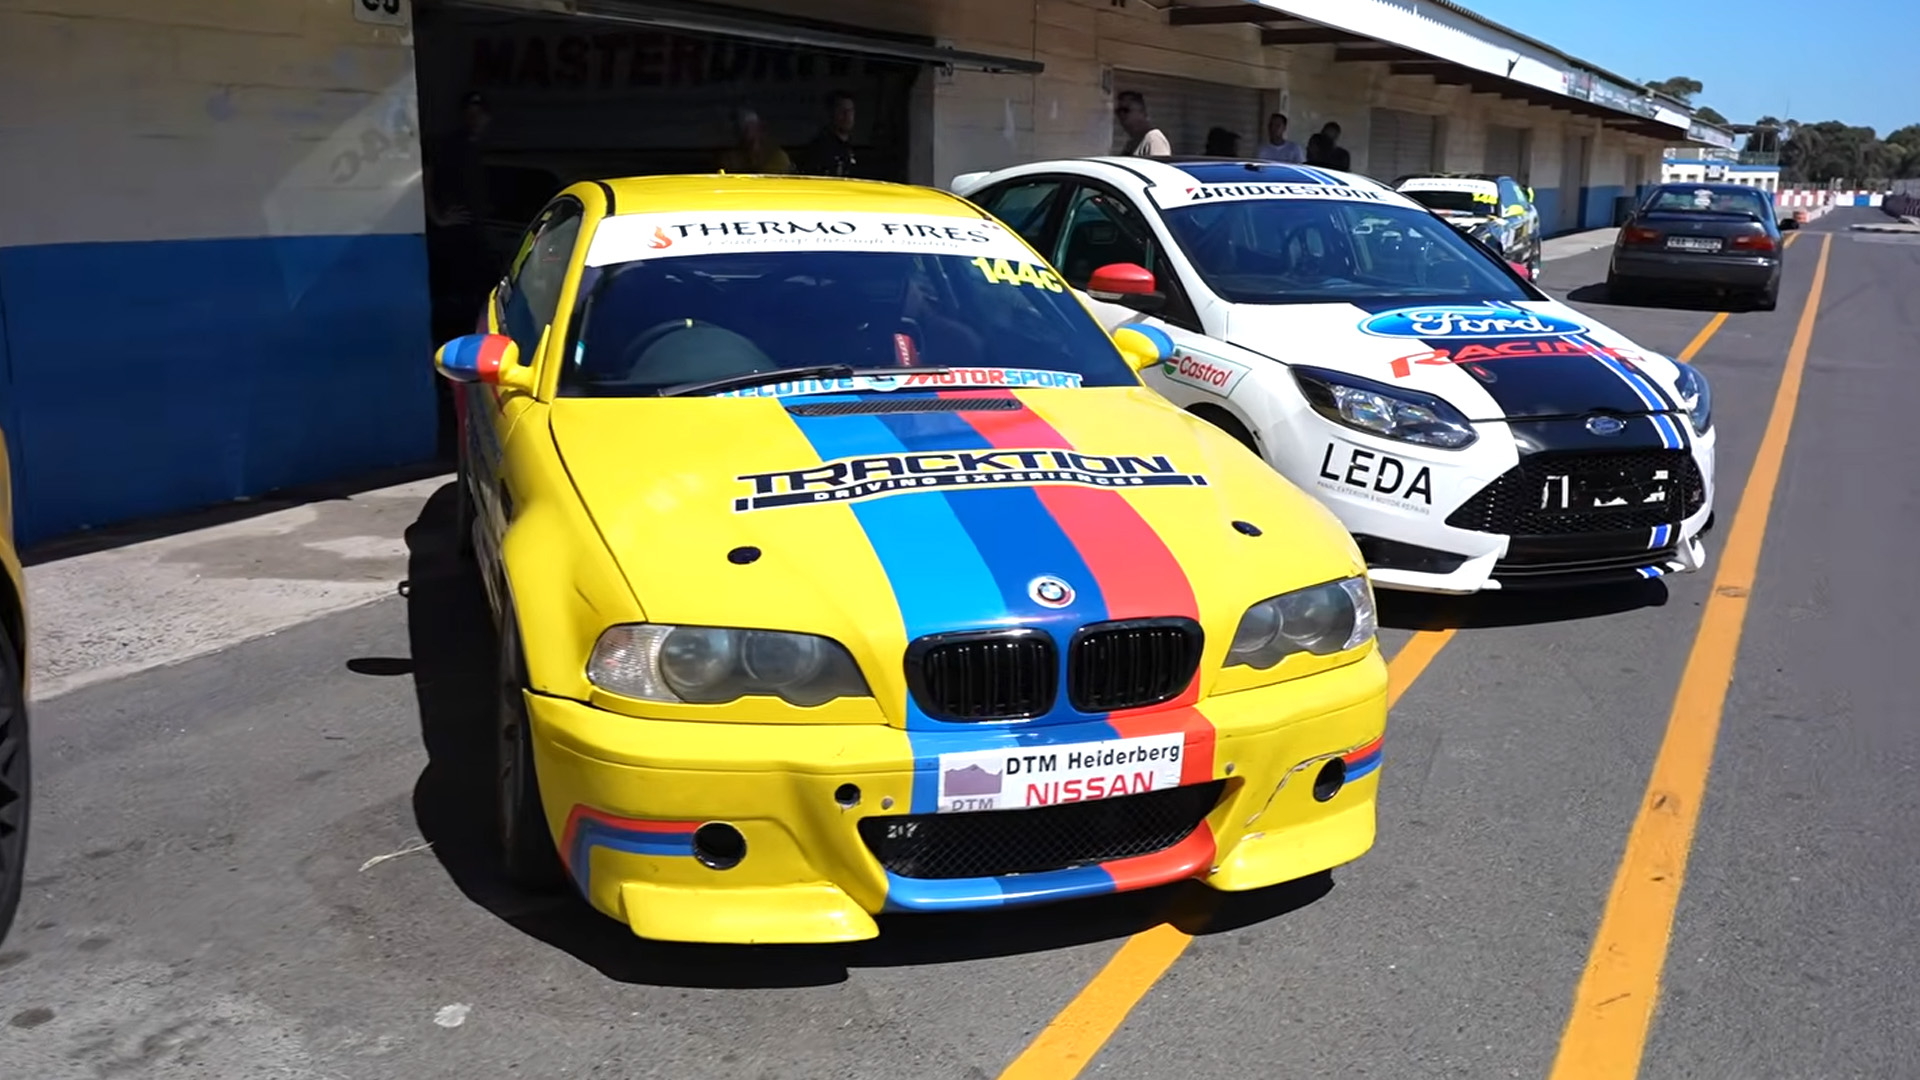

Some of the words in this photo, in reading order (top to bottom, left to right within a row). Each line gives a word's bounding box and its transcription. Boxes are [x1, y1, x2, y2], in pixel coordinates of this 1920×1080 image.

[1191, 184, 1388, 202] BRIDGESTONE
[671, 220, 857, 239] THERMO
[881, 222, 991, 244] FIRES
[1407, 310, 1555, 336] Ford
[1179, 355, 1233, 387] Castrol
[737, 451, 1174, 495] TRACKTION
[814, 475, 948, 502] DRIVING
[955, 472, 1144, 486] EXPERIENCES
[1320, 442, 1432, 506] LEDA
[1006, 755, 1057, 776] DTM
[1025, 771, 1155, 807] NISSAN
[952, 798, 994, 812] DTM
